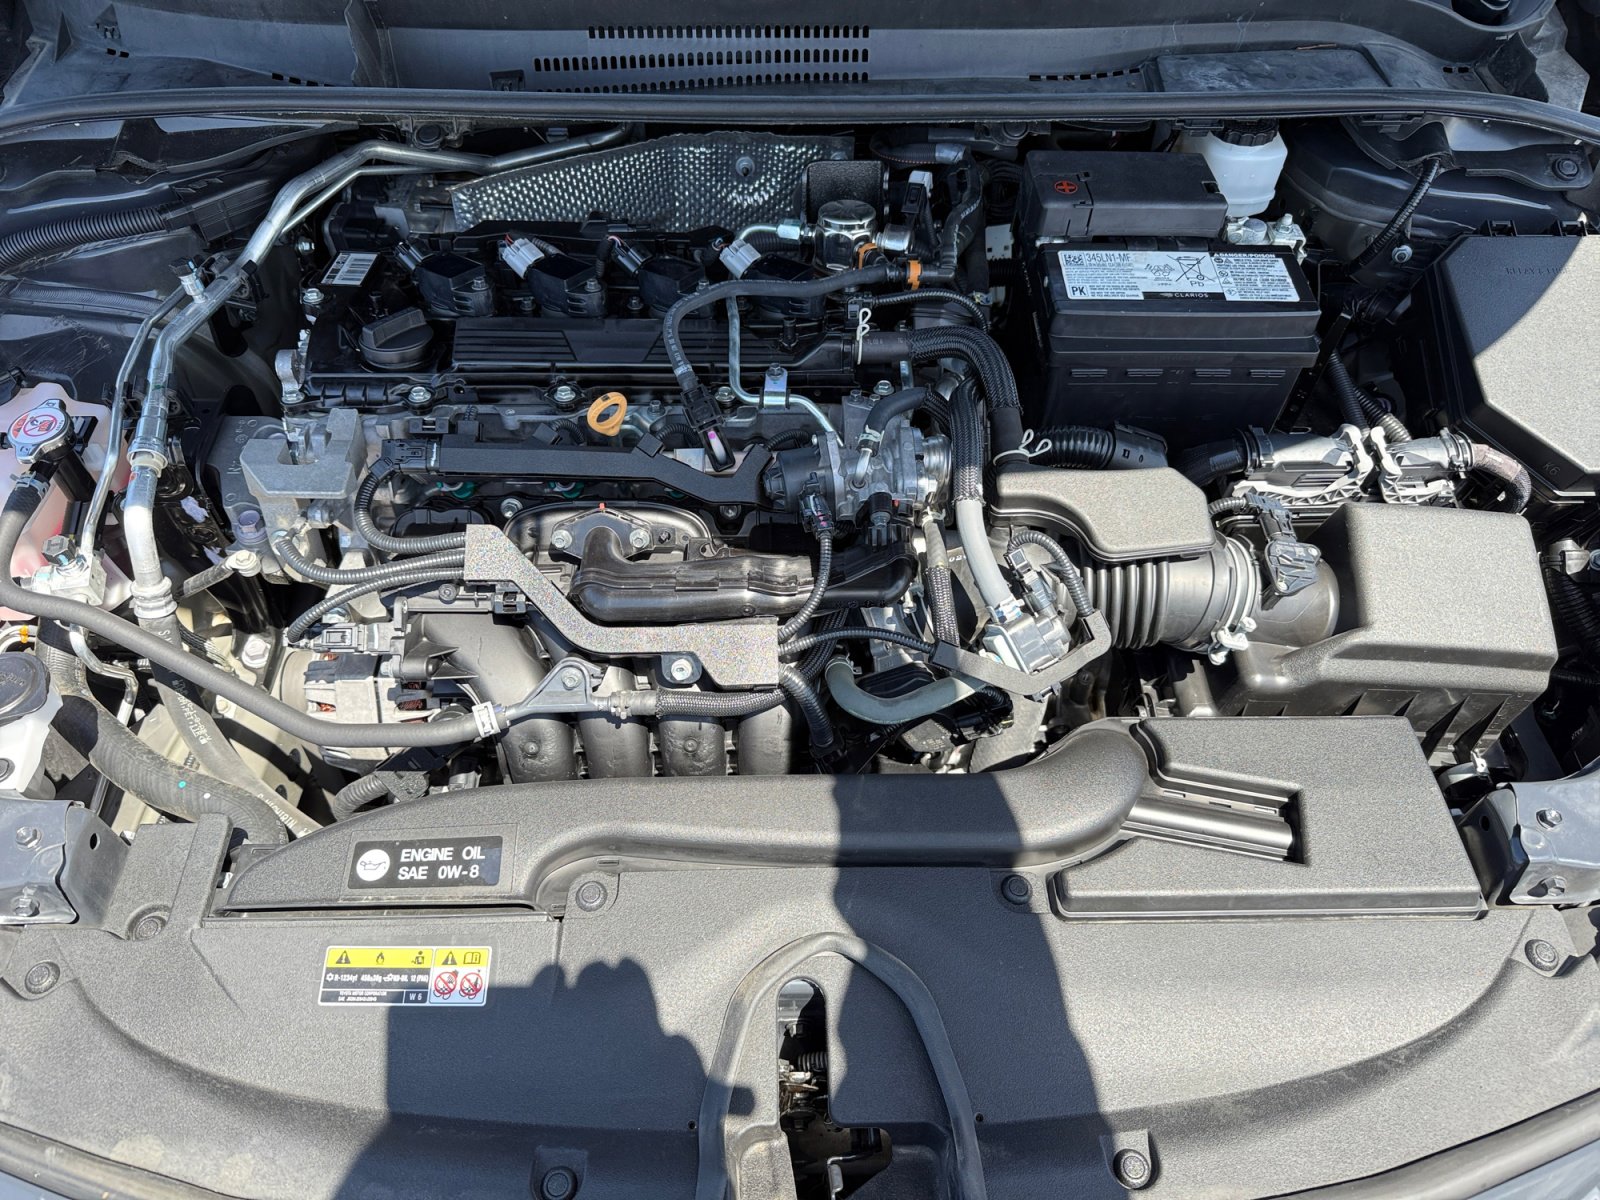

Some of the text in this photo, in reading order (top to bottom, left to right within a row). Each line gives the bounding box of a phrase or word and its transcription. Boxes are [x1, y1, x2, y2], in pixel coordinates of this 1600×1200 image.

[1086, 253, 1131, 262] 345LN1-MF
[1072, 286, 1087, 296] PK
[400, 846, 485, 862] ENGINE OIL
[397, 864, 480, 880] SAE 0W-8
